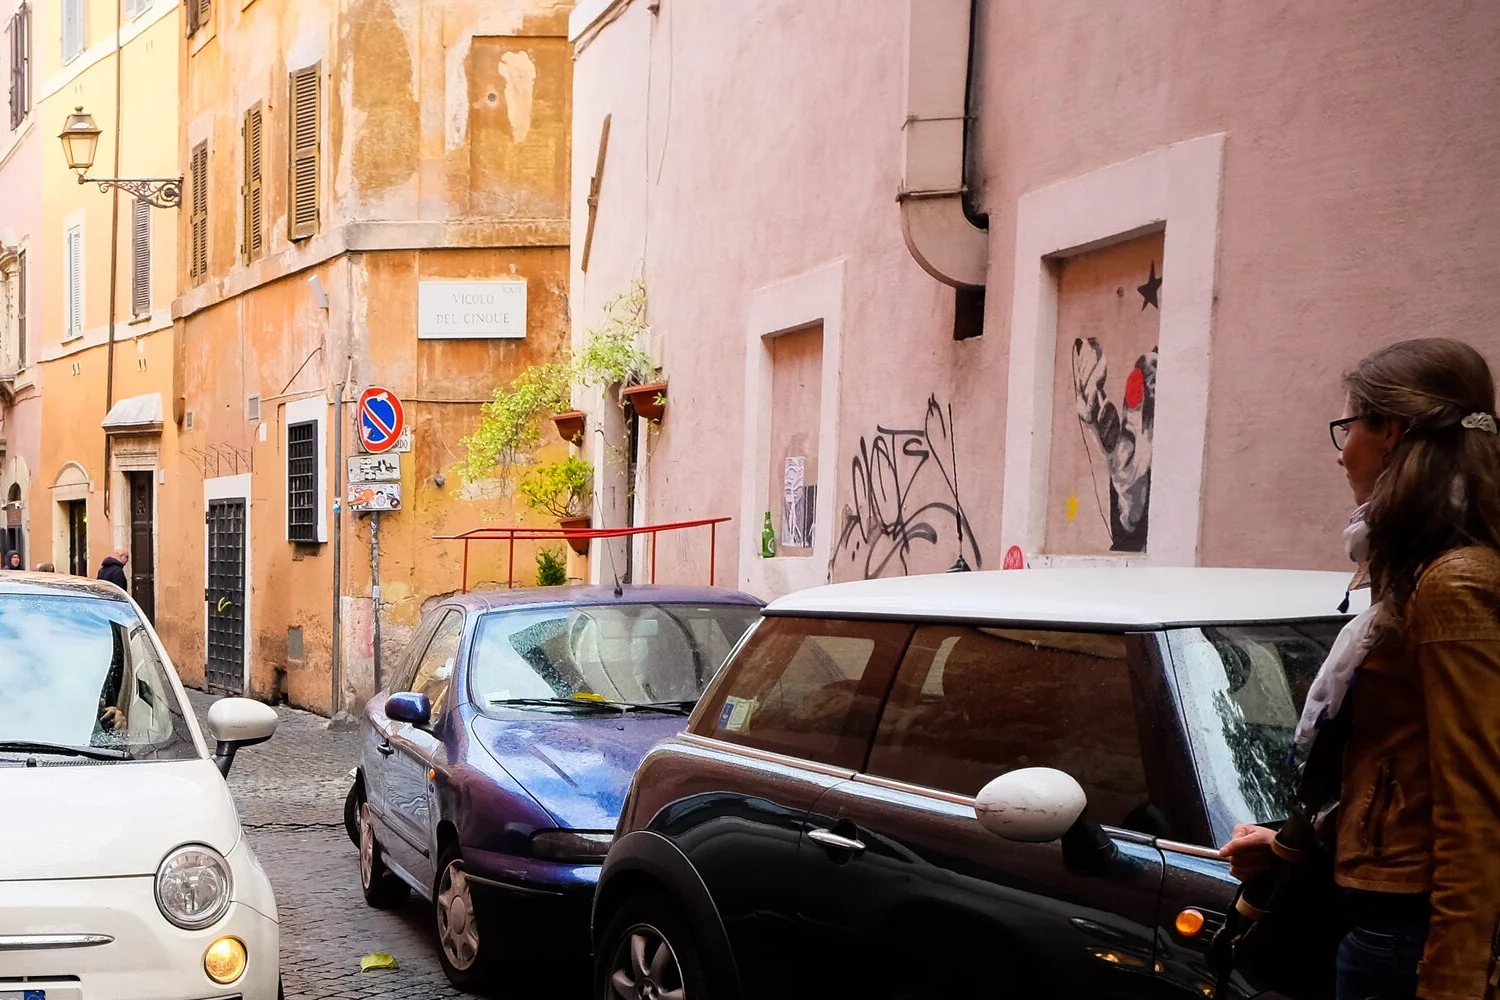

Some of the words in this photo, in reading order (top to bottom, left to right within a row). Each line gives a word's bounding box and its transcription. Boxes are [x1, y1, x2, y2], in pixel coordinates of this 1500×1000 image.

[452, 293, 494, 304] VICOLO
[436, 313, 458, 324] DEL
[463, 312, 510, 324] CINQUE
